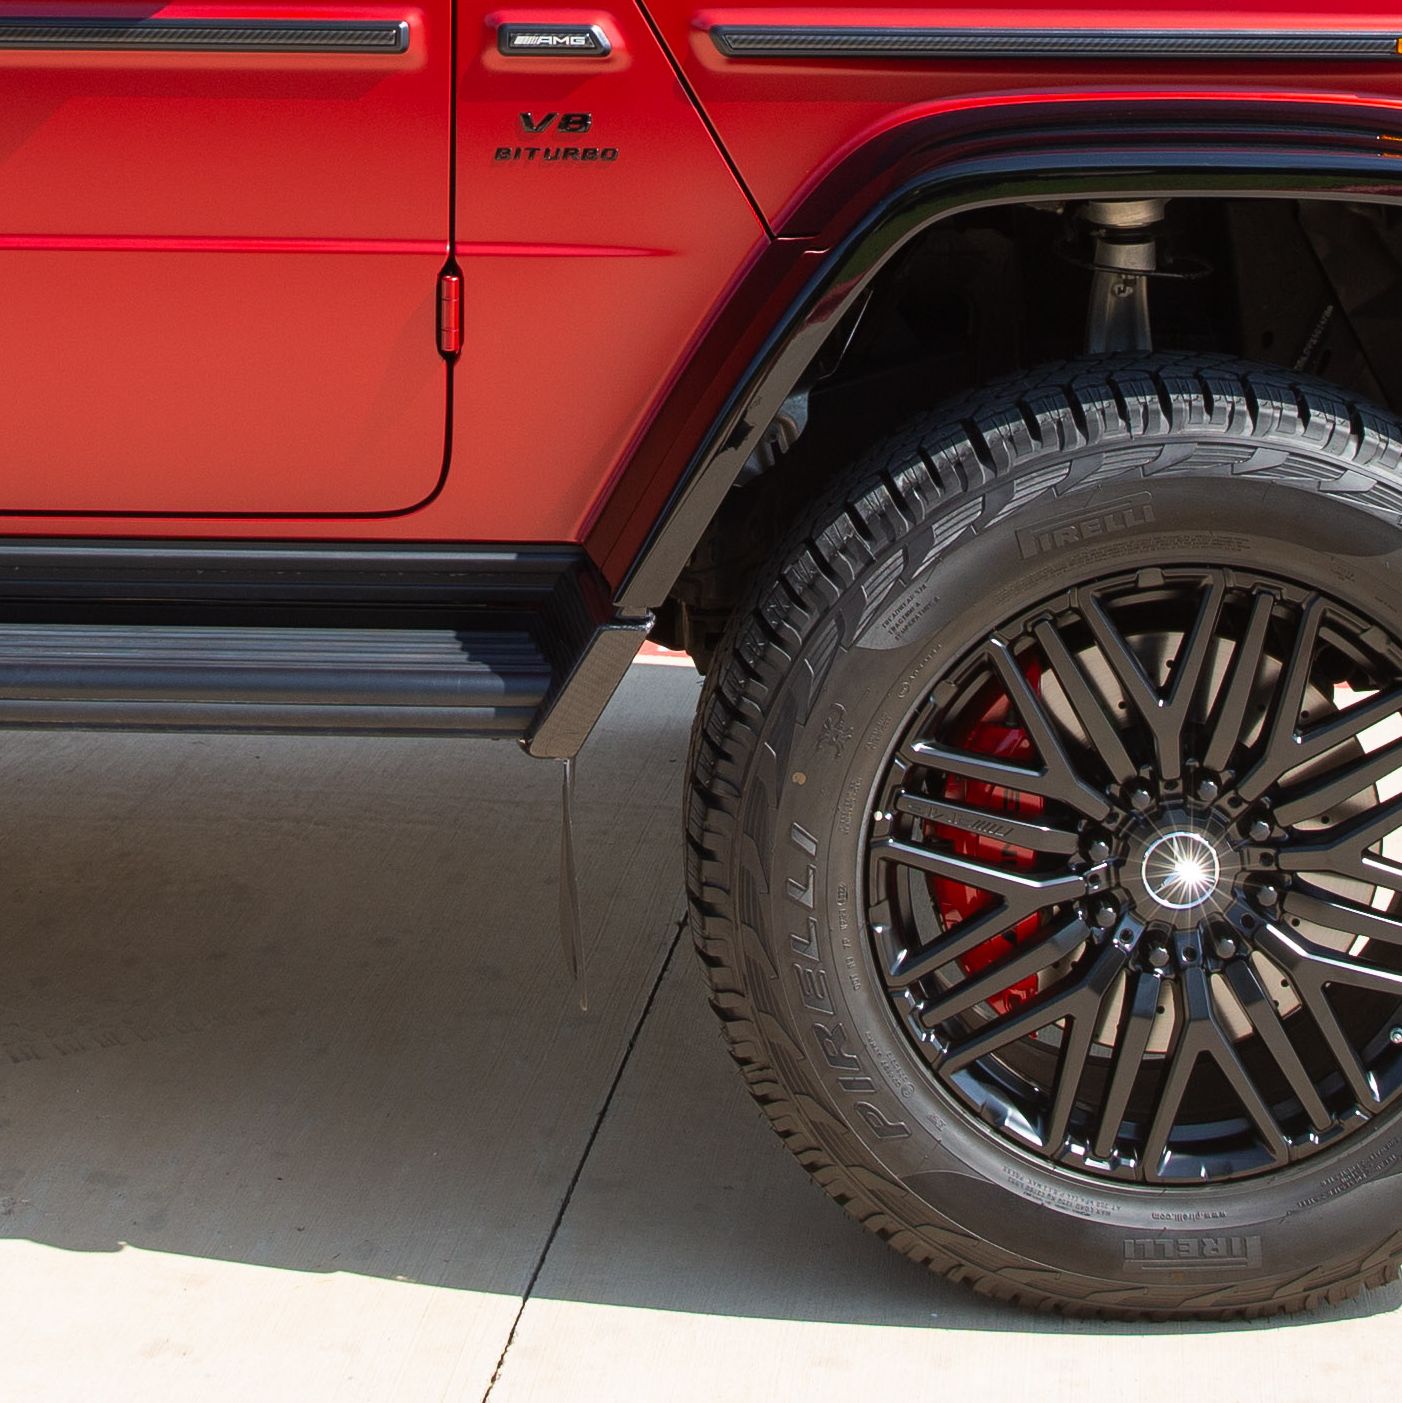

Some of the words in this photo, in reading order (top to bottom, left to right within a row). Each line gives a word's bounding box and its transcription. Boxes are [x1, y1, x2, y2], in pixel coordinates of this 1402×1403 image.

[519, 112, 592, 133] V8
[494, 147, 619, 162] BITURBO
[1015, 491, 1155, 558] PIRELLI
[785, 821, 913, 1140] PIRELLI
[1122, 1235, 1262, 1271] PIRELLI
